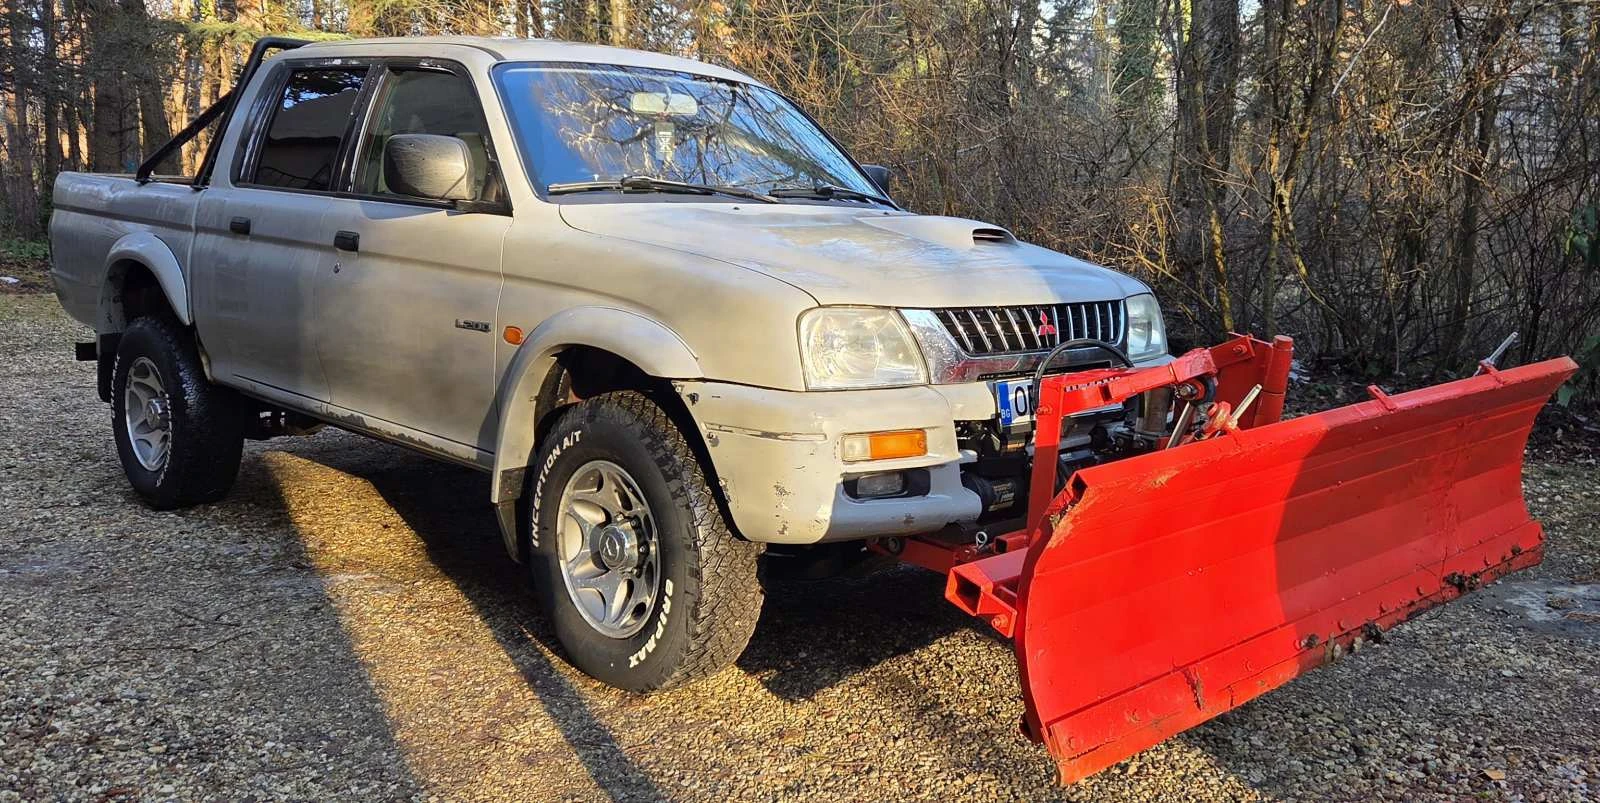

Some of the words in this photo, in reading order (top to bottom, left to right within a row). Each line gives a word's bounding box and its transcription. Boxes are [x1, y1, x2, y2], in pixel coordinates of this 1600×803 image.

[455, 319, 490, 332] L200
[1001, 408, 1011, 419] BG
[532, 445, 562, 548] INCEPTION
[562, 429, 583, 451] A/T
[628, 578, 674, 669] GRIPMAX
